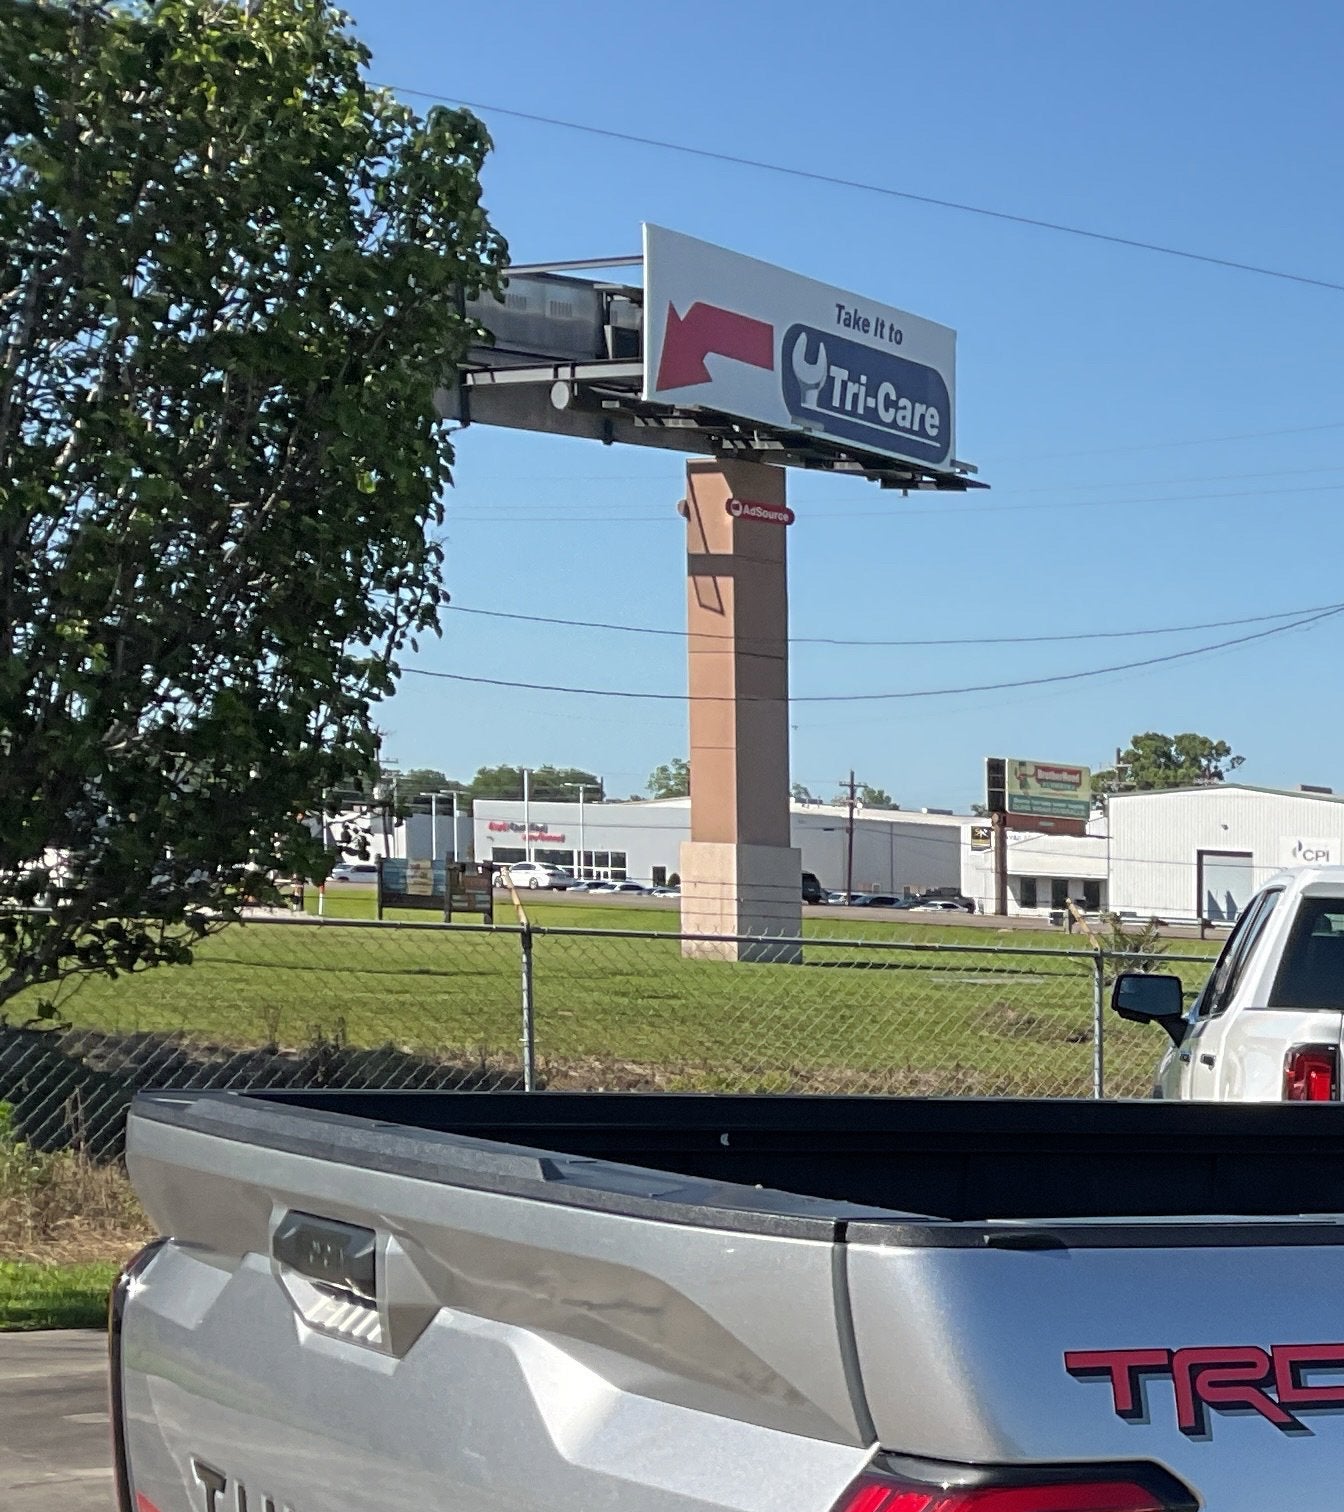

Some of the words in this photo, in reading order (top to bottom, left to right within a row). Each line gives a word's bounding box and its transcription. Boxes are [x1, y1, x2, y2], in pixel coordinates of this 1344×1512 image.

[836, 303, 871, 334] Take
[888, 322, 903, 345] to
[829, 365, 940, 437] Tri-Care
[743, 504, 789, 521] AdSource
[1302, 849, 1330, 863] CPI
